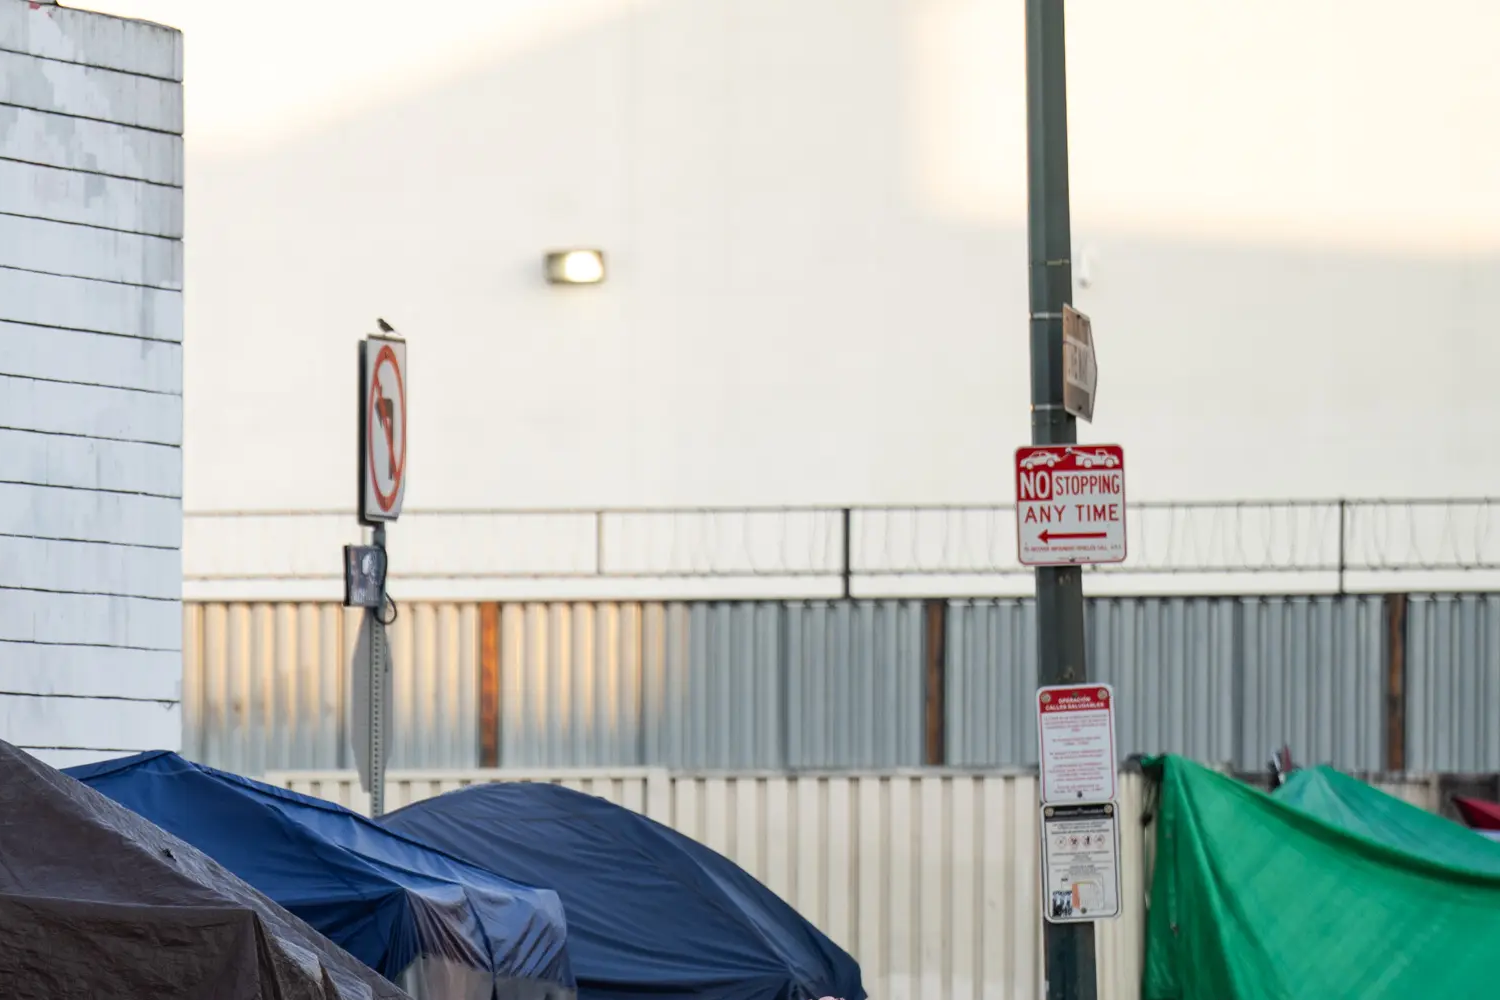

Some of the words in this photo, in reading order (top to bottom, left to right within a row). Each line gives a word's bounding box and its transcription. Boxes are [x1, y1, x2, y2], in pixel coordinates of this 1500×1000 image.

[1019, 470, 1051, 500] NO
[1055, 474, 1120, 496] STOPPING
[1024, 504, 1066, 524] ANY
[1075, 503, 1119, 522] TIME
